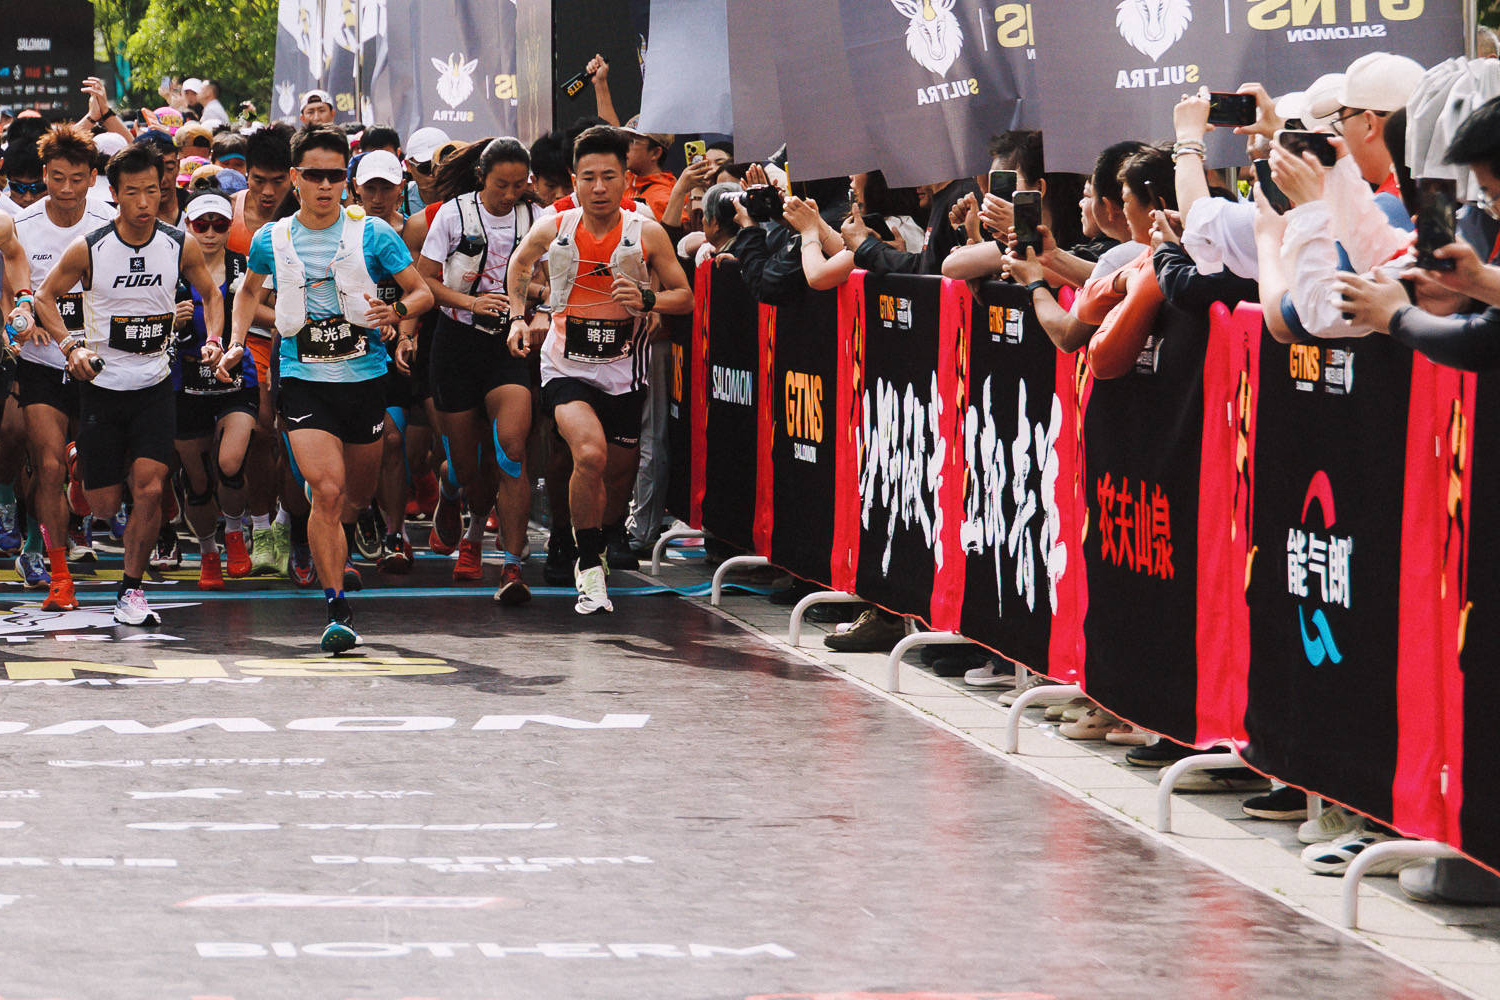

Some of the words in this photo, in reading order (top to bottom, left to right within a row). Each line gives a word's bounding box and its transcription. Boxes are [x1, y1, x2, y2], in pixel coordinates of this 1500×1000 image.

[112, 274, 163, 289] FUGA
[1289, 343, 1321, 382] GTNS
[712, 364, 753, 407] SALOMON
[785, 370, 823, 443] GTNS
[794, 442, 817, 464] SALOMON
[1097, 472, 1175, 580] 农夫山泉
[194, 942, 798, 958] BIOTHERM
